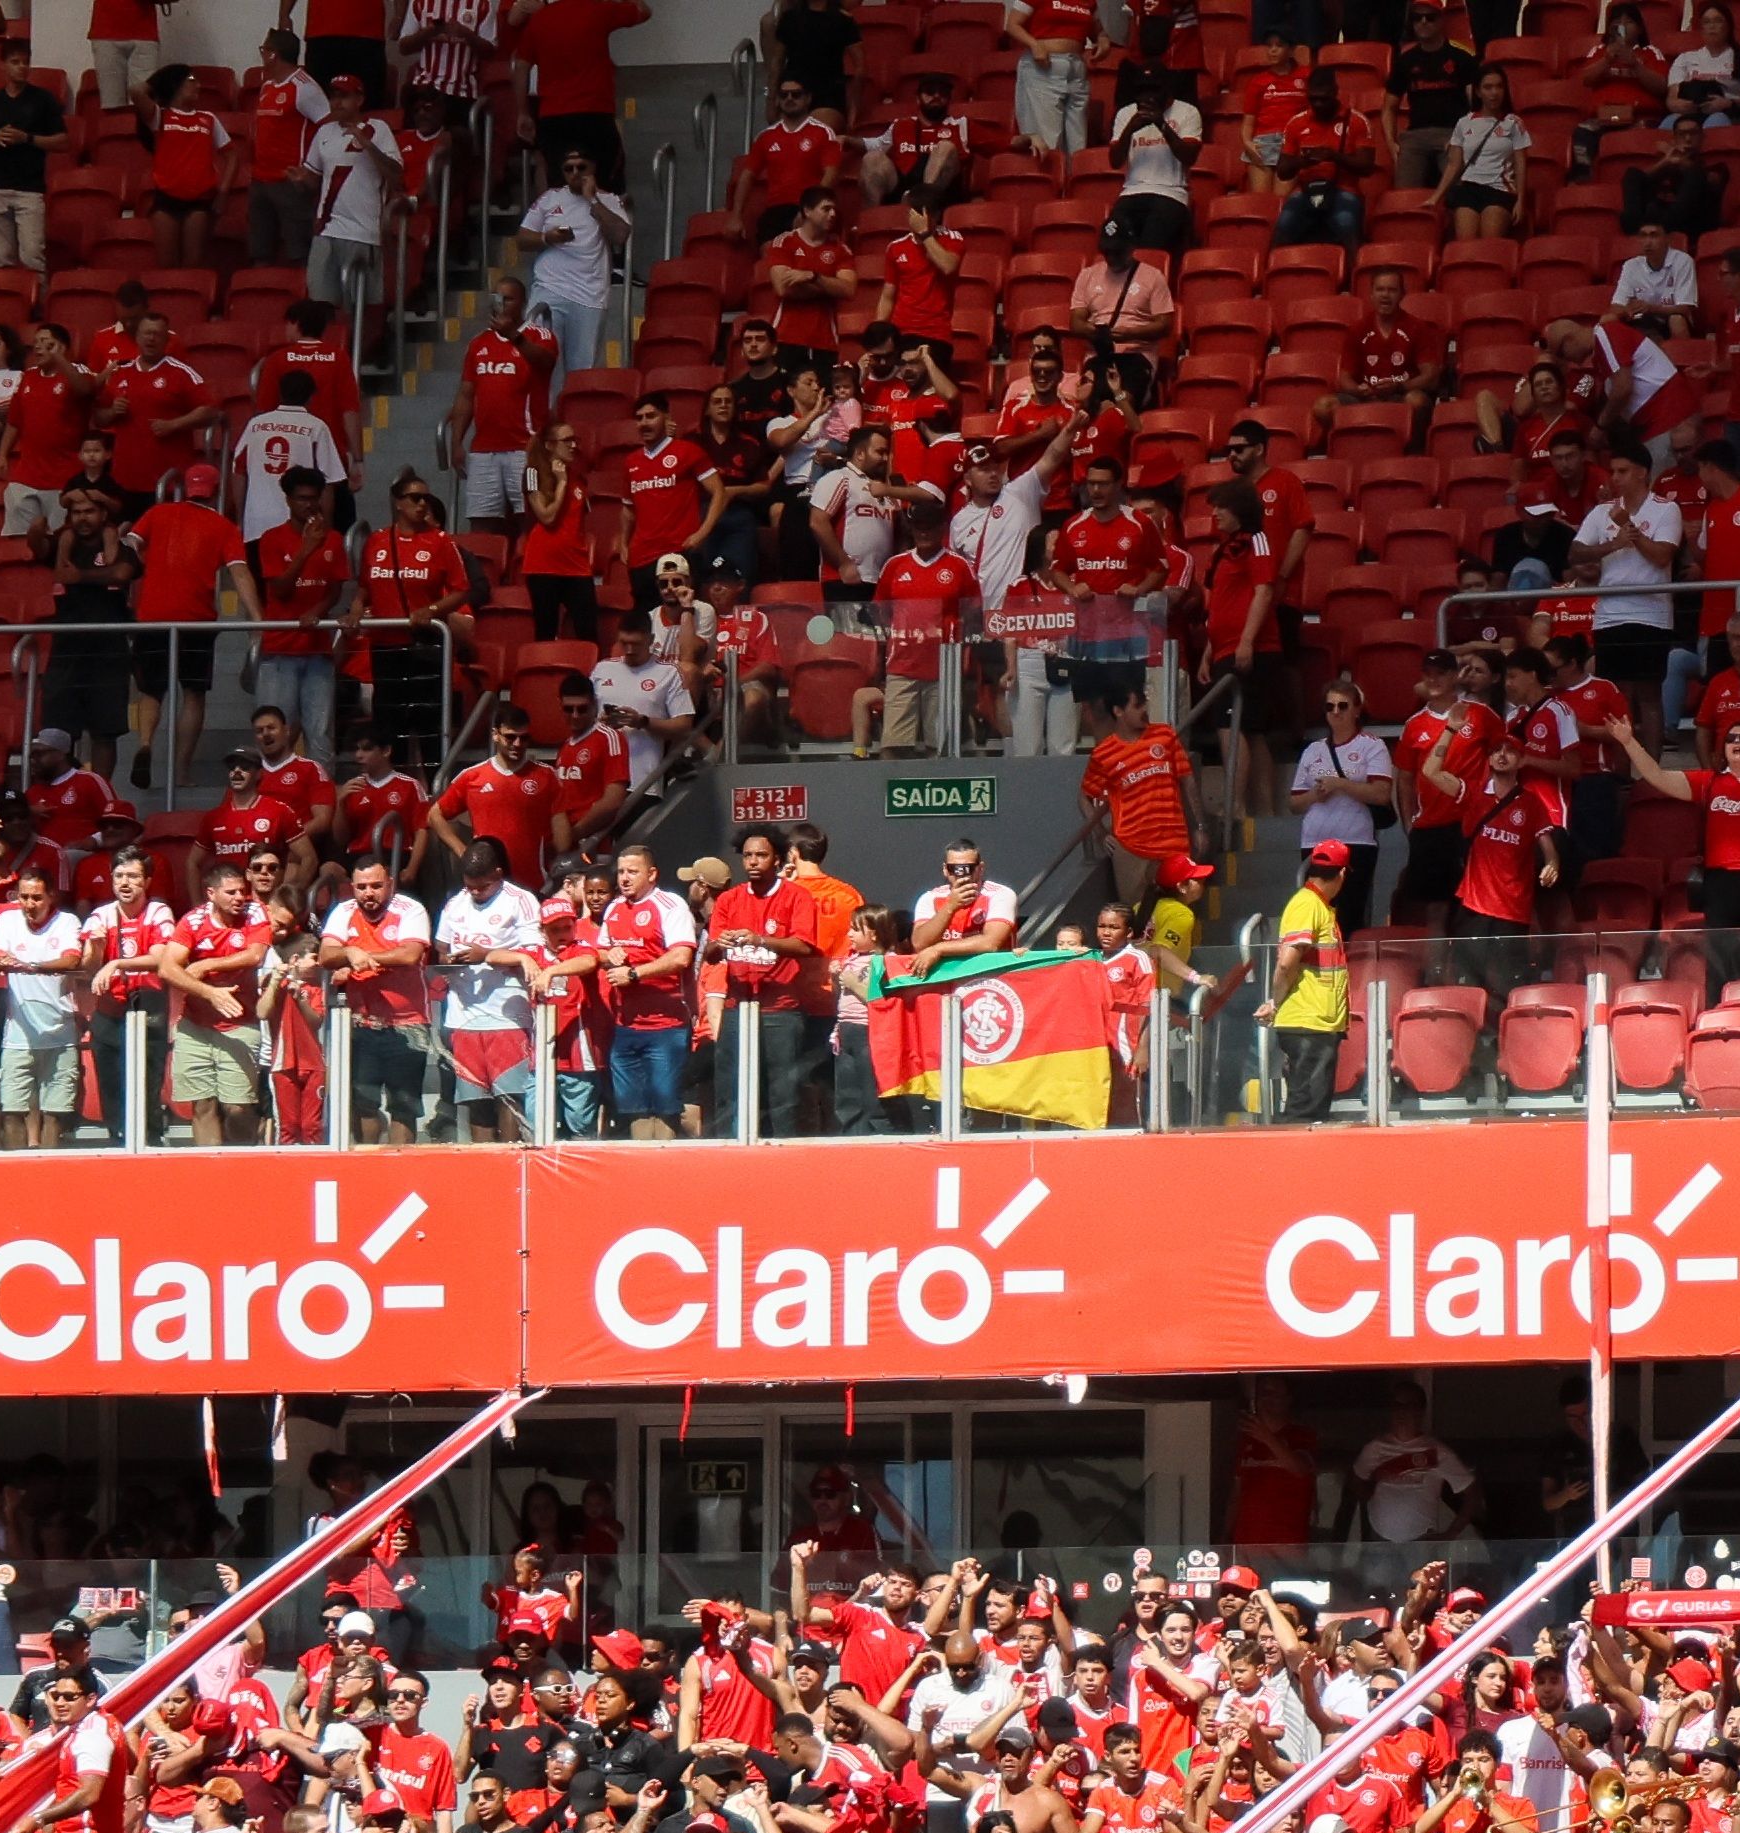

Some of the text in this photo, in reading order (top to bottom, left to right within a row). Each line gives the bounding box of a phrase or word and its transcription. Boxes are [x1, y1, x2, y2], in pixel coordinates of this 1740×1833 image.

[286, 352, 335, 361] Banrisul
[476, 361, 516, 374] alfa
[631, 476, 675, 490] Banrisul
[375, 550, 387, 562] 9
[1075, 557, 1130, 569] Banrisul
[1005, 614, 1076, 632] CEVADOS
[755, 789, 785, 804] 312
[892, 786, 963, 808] SAÍDA
[775, 804, 804, 820] 311
[1266, 1213, 1666, 1338] Claro
[595, 1226, 992, 1350] Claro
[1673, 1600, 1731, 1613] GURIAS
[379, 1768, 425, 1790] nrisul
